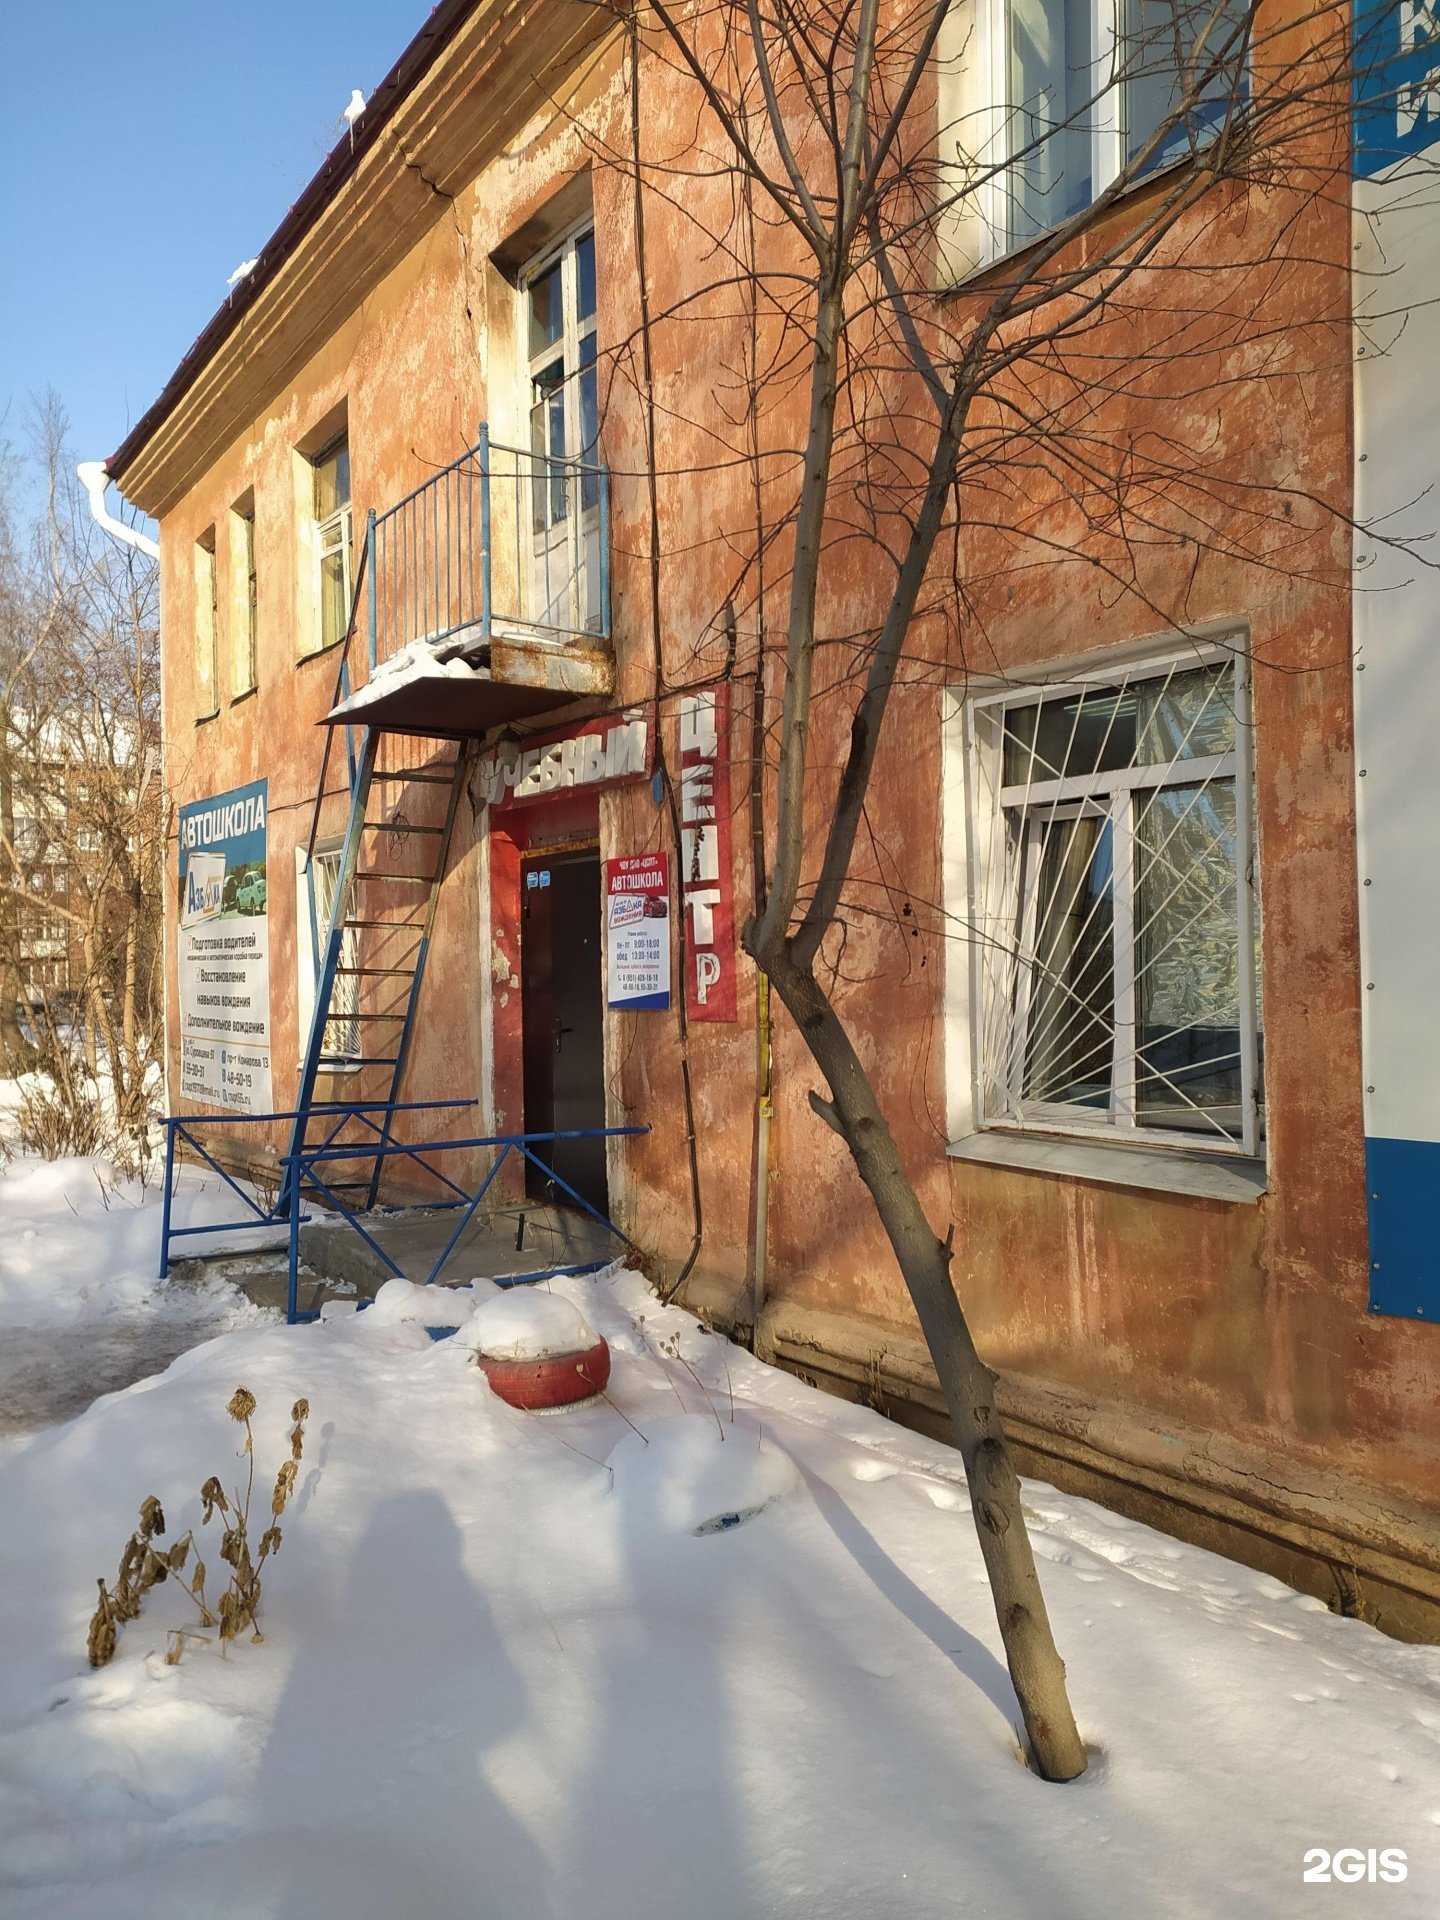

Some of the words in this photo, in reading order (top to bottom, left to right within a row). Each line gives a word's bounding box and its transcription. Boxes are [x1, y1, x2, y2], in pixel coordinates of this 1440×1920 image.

[180, 795, 265, 850] АВТОШКОЛА
[679, 691, 722, 1004] ЦЕНТР
[611, 871, 664, 891] АВТОШКОЛА
[192, 937, 223, 952] Подготовка
[224, 932, 256, 950] водителей
[201, 968, 246, 983] Восстановление
[197, 994, 221, 1006] навыков
[222, 996, 251, 1009] вождения
[188, 1012, 232, 1031] Дополнительное
[232, 1021, 265, 1035] вождение
[237, 1054, 262, 1068] Комарова
[262, 1057, 269, 1069] 13
[227, 1071, 252, 1087] 48-50-19
